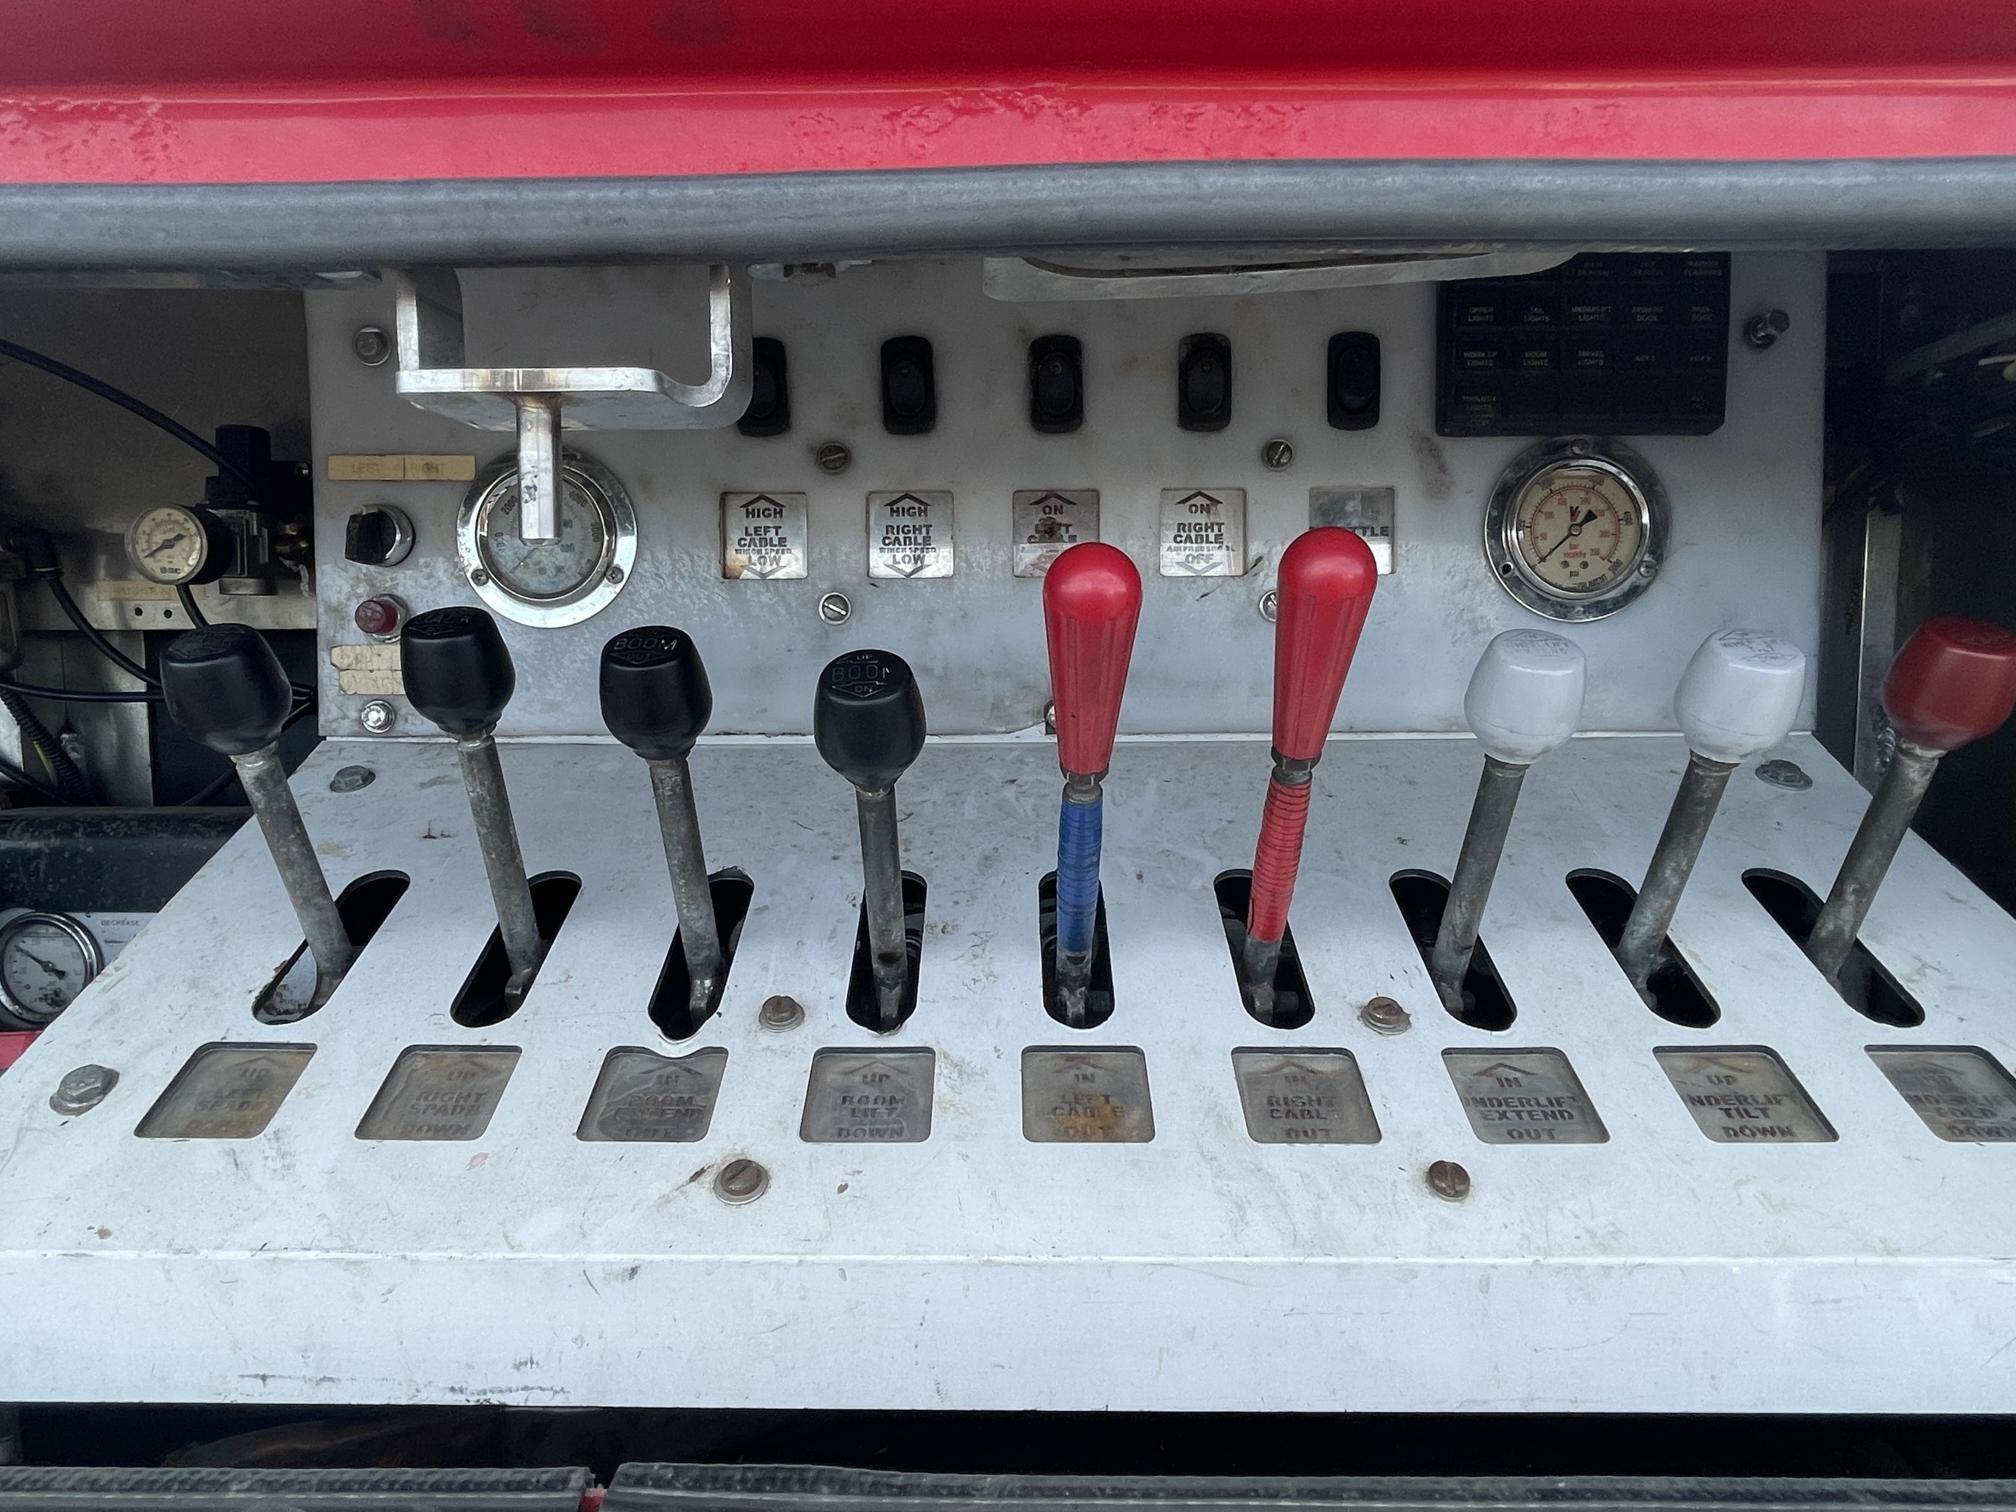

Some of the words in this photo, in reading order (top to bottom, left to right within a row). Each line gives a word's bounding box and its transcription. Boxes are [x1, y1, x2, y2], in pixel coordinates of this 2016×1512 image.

[745, 507, 784, 519] HIGH
[889, 506, 929, 517] HIGH
[1042, 505, 1065, 515] ON
[1188, 503, 1211, 515] ON
[744, 526, 783, 537] LEFT
[885, 524, 934, 535] RIGHT
[1176, 521, 1225, 533] RIGHT
[737, 537, 788, 548] CABLE
[881, 535, 933, 547] CABLE
[1172, 533, 1225, 545] CABLE
[747, 555, 783, 566] LOW
[892, 554, 927, 565] LOW
[101, 919, 140, 927] DECREASE
[861, 1073, 891, 1085] UP
[1495, 1077, 1523, 1088] IN
[1706, 1075, 1738, 1086] UP
[415, 1090, 489, 1103] RIGHT
[628, 1095, 695, 1107] BOOM
[840, 1095, 906, 1106] BOOM
[1266, 1095, 1338, 1108] RIGHT
[1686, 1094, 1792, 1106] NDERLIF
[408, 1103, 481, 1117] SPADE
[850, 1107, 899, 1118] LIFT
[1479, 1110, 1576, 1121] EXTEND
[1717, 1107, 1771, 1119] TILT
[399, 1123, 472, 1136] DOWN
[837, 1127, 905, 1139] DOWN
[1285, 1127, 1332, 1139] OUT
[1506, 1128, 1557, 1140] OUT
[1721, 1126, 1797, 1138] DOWN
